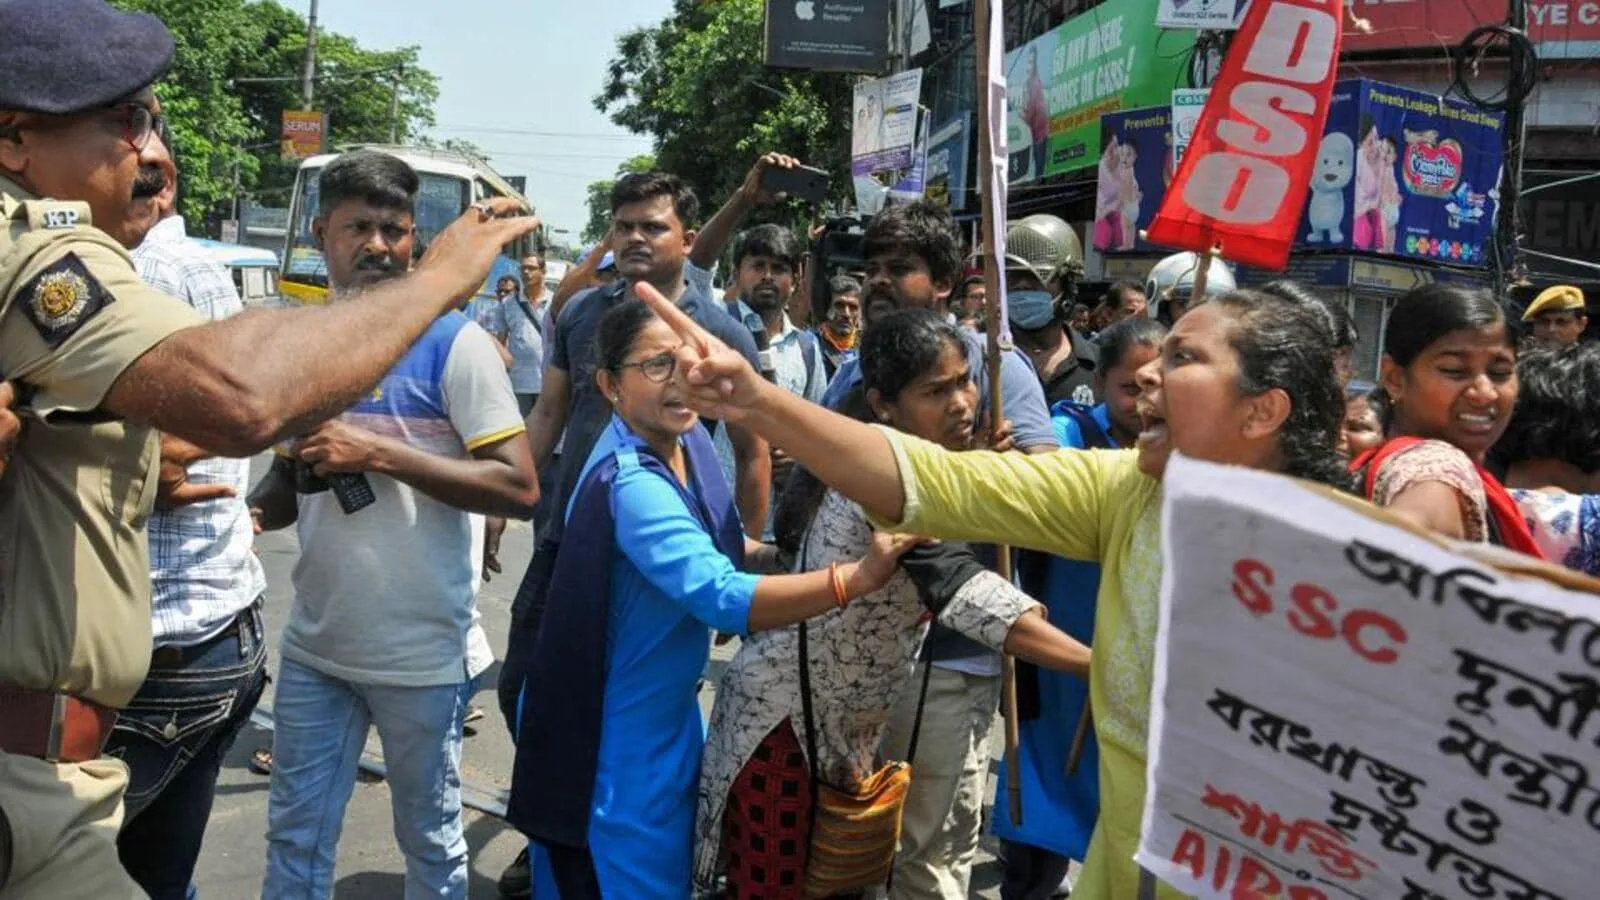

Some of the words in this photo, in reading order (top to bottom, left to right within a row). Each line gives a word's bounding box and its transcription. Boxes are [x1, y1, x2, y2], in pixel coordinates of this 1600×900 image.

[1124, 113, 1165, 130] Prevents
[1183, 0, 1337, 225] DSO
[43, 208, 77, 227] KP
[1232, 558, 1408, 664] SSC
[1206, 687, 1427, 809] বরখাস্ত
[1446, 798, 1501, 845] ও
